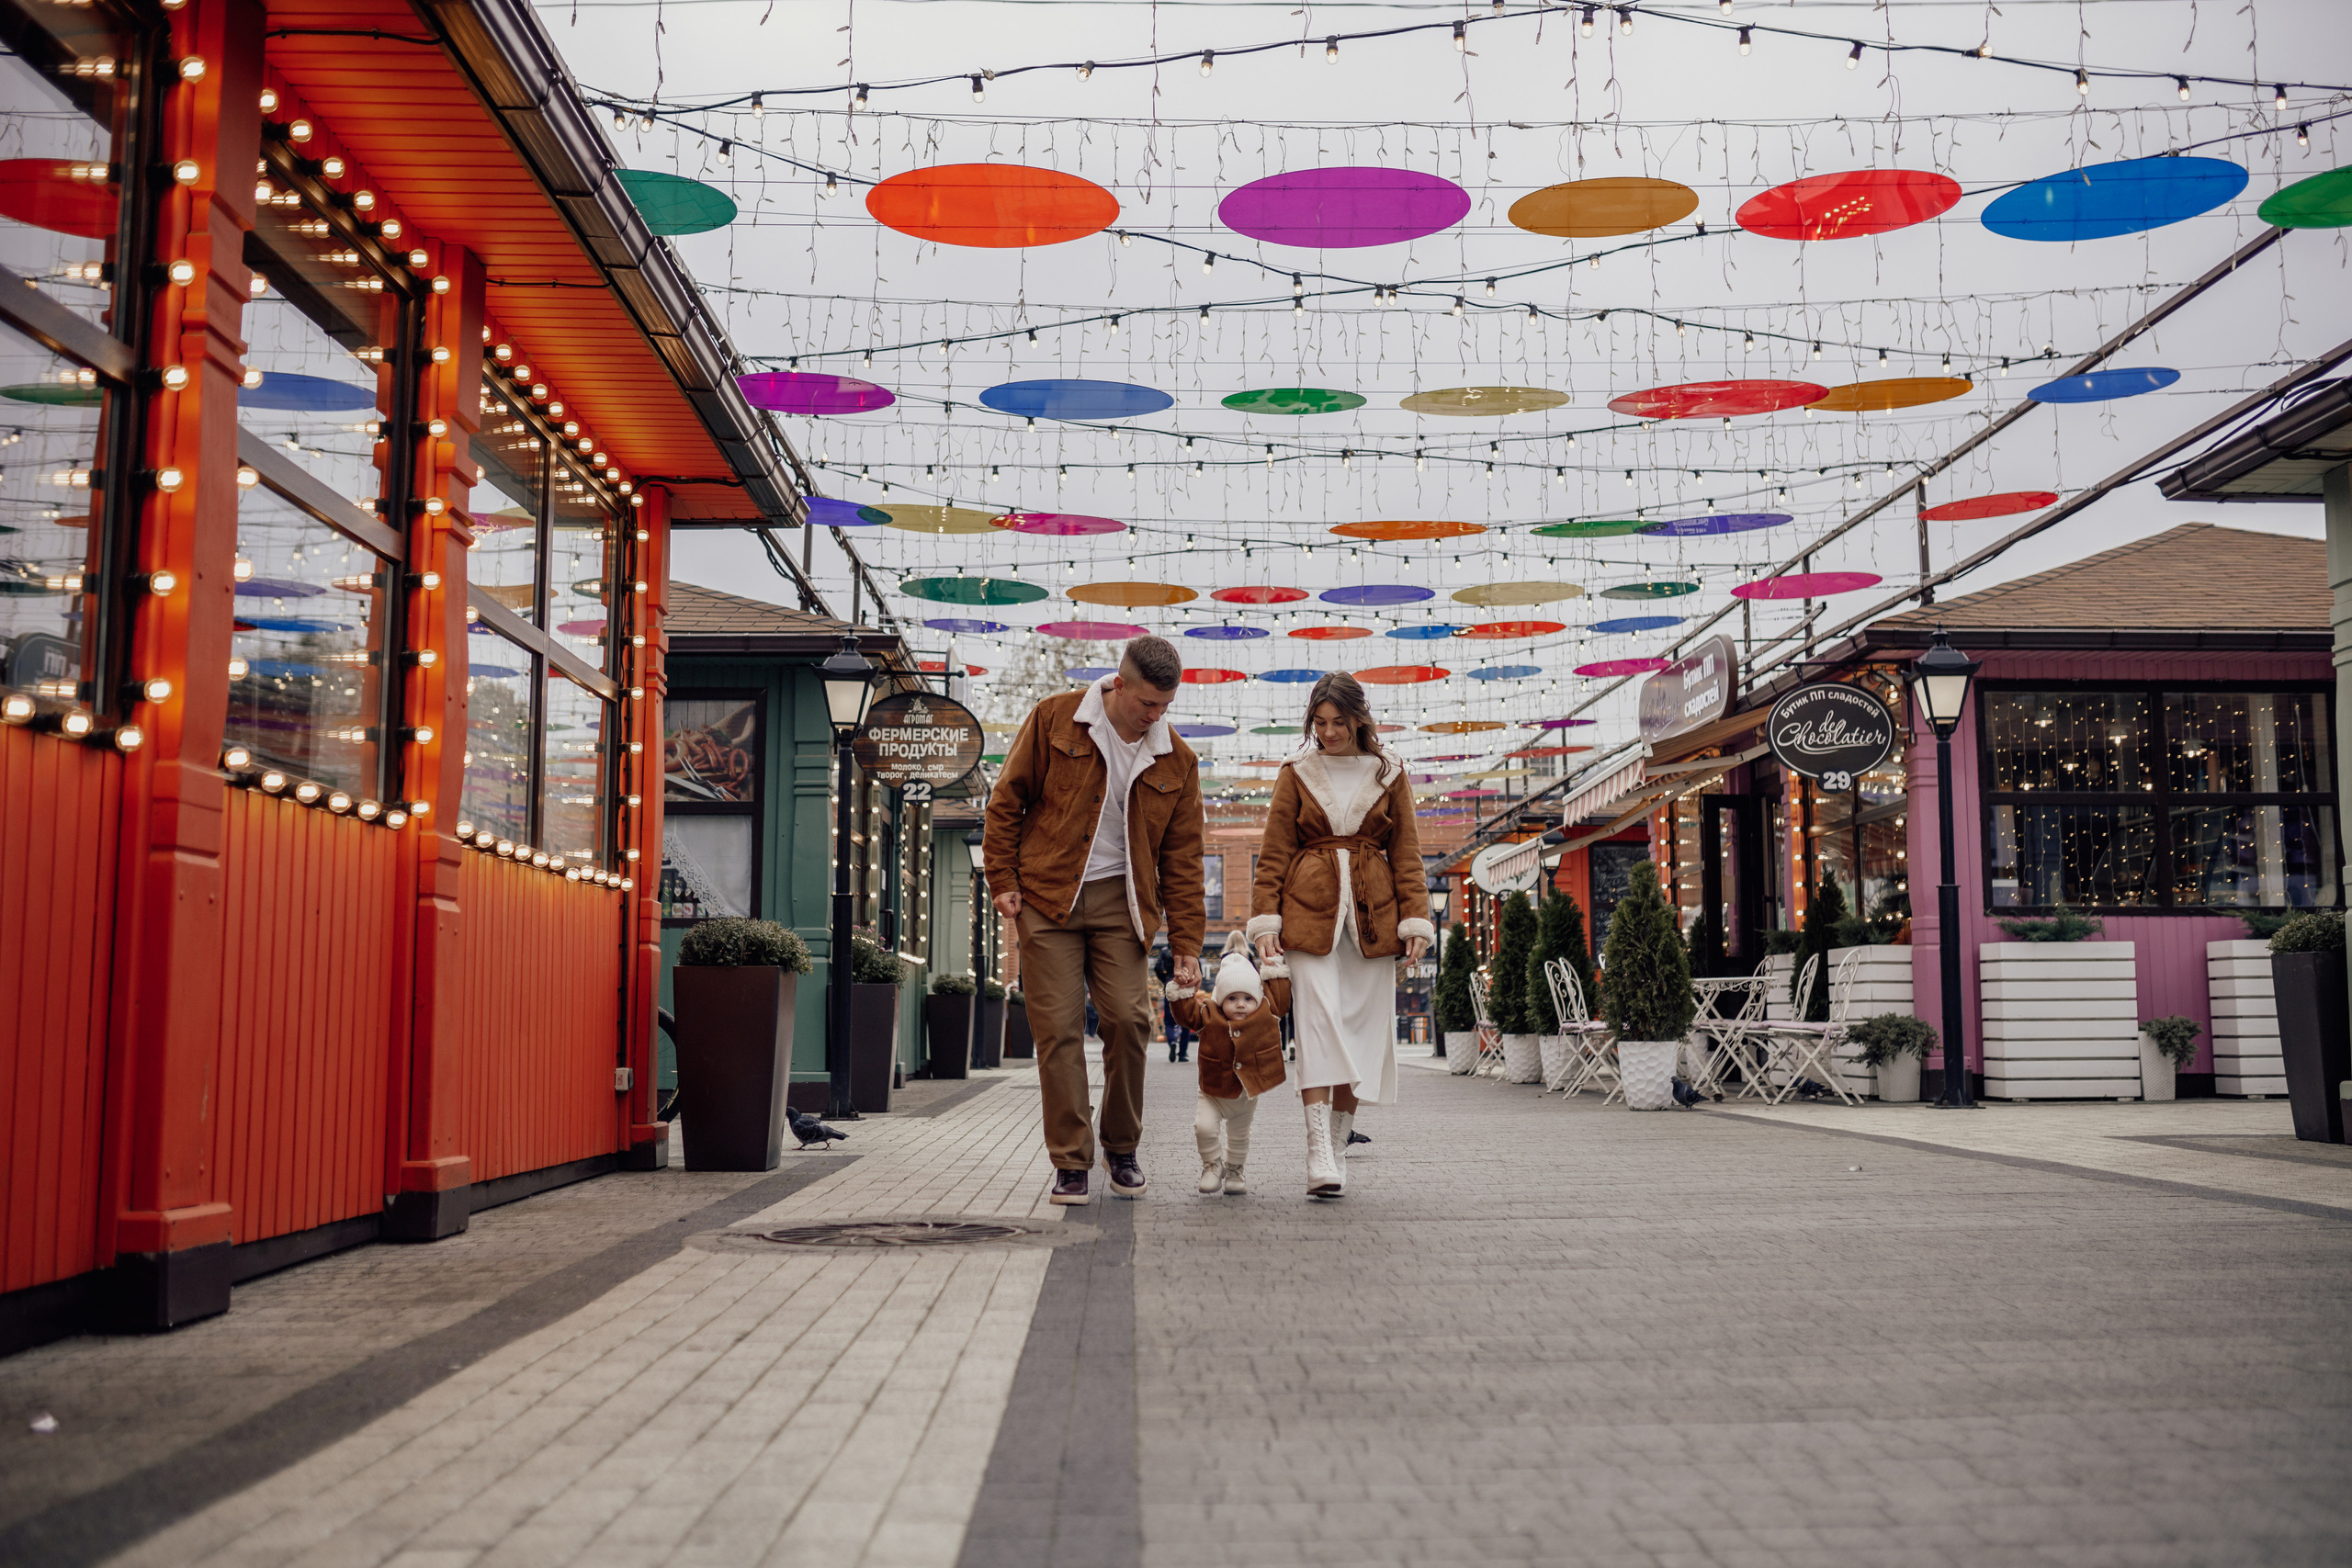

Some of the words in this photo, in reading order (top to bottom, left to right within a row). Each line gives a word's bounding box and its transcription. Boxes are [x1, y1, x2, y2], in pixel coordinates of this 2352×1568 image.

[1683, 664, 1703, 693] Бутик
[1702, 653, 1714, 679] ПП
[1684, 678, 1721, 718] сладостей
[1781, 695, 1809, 719] Бутик
[1809, 690, 1826, 702] ПП
[1827, 691, 1881, 718] сладостей
[903, 714, 933, 725] АГРОМАГ
[1819, 710, 1836, 733] de
[868, 728, 969, 742] ФЕРМЕРСКИЕ
[1777, 718, 1886, 754] Chocolatier
[879, 742, 957, 760] ПРОДУКТЫ
[909, 772, 958, 780] деликатесы
[927, 763, 944, 773] сыр
[1823, 771, 1851, 790] 29
[902, 783, 932, 800] 22
